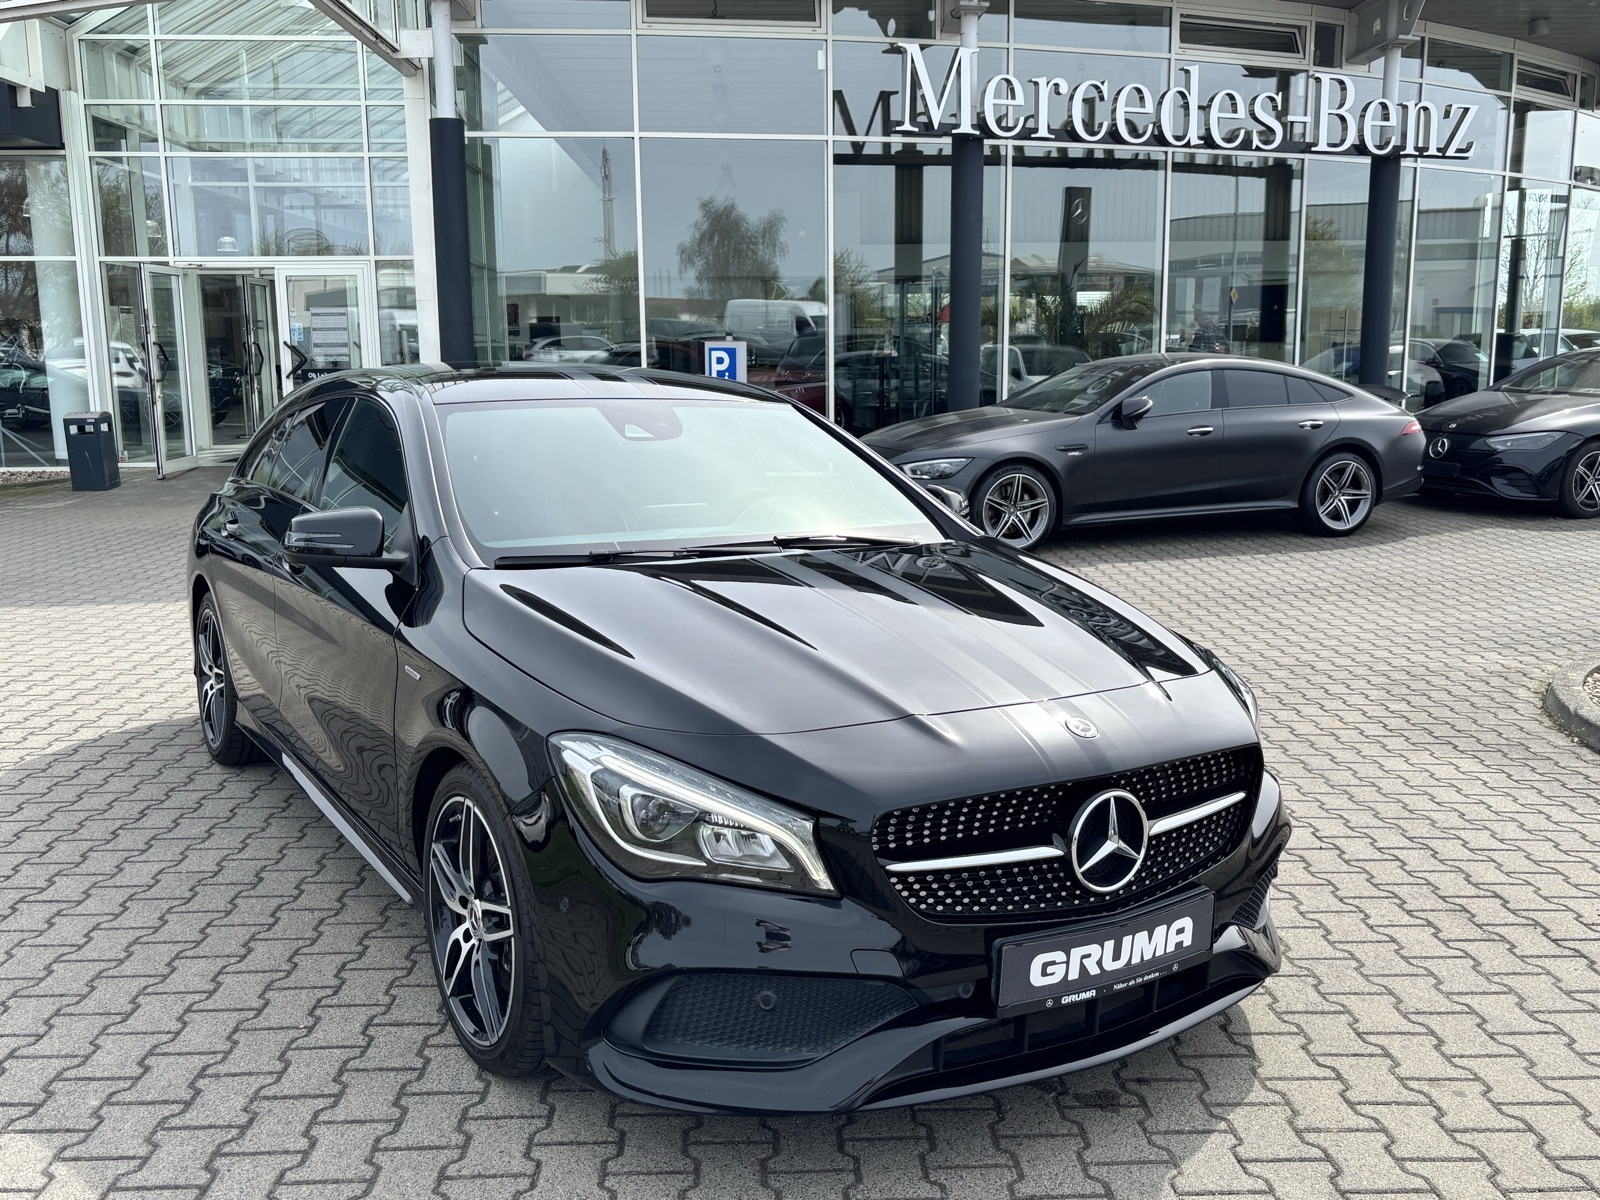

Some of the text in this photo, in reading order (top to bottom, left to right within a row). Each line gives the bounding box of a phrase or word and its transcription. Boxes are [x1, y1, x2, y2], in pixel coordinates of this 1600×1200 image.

[897, 43, 1477, 158] Mercedes-Benz
[711, 350, 730, 378] P
[1029, 916, 1193, 987] GRUMA
[1061, 989, 1096, 1004] GRUMA
[1135, 976, 1143, 984] Sie
